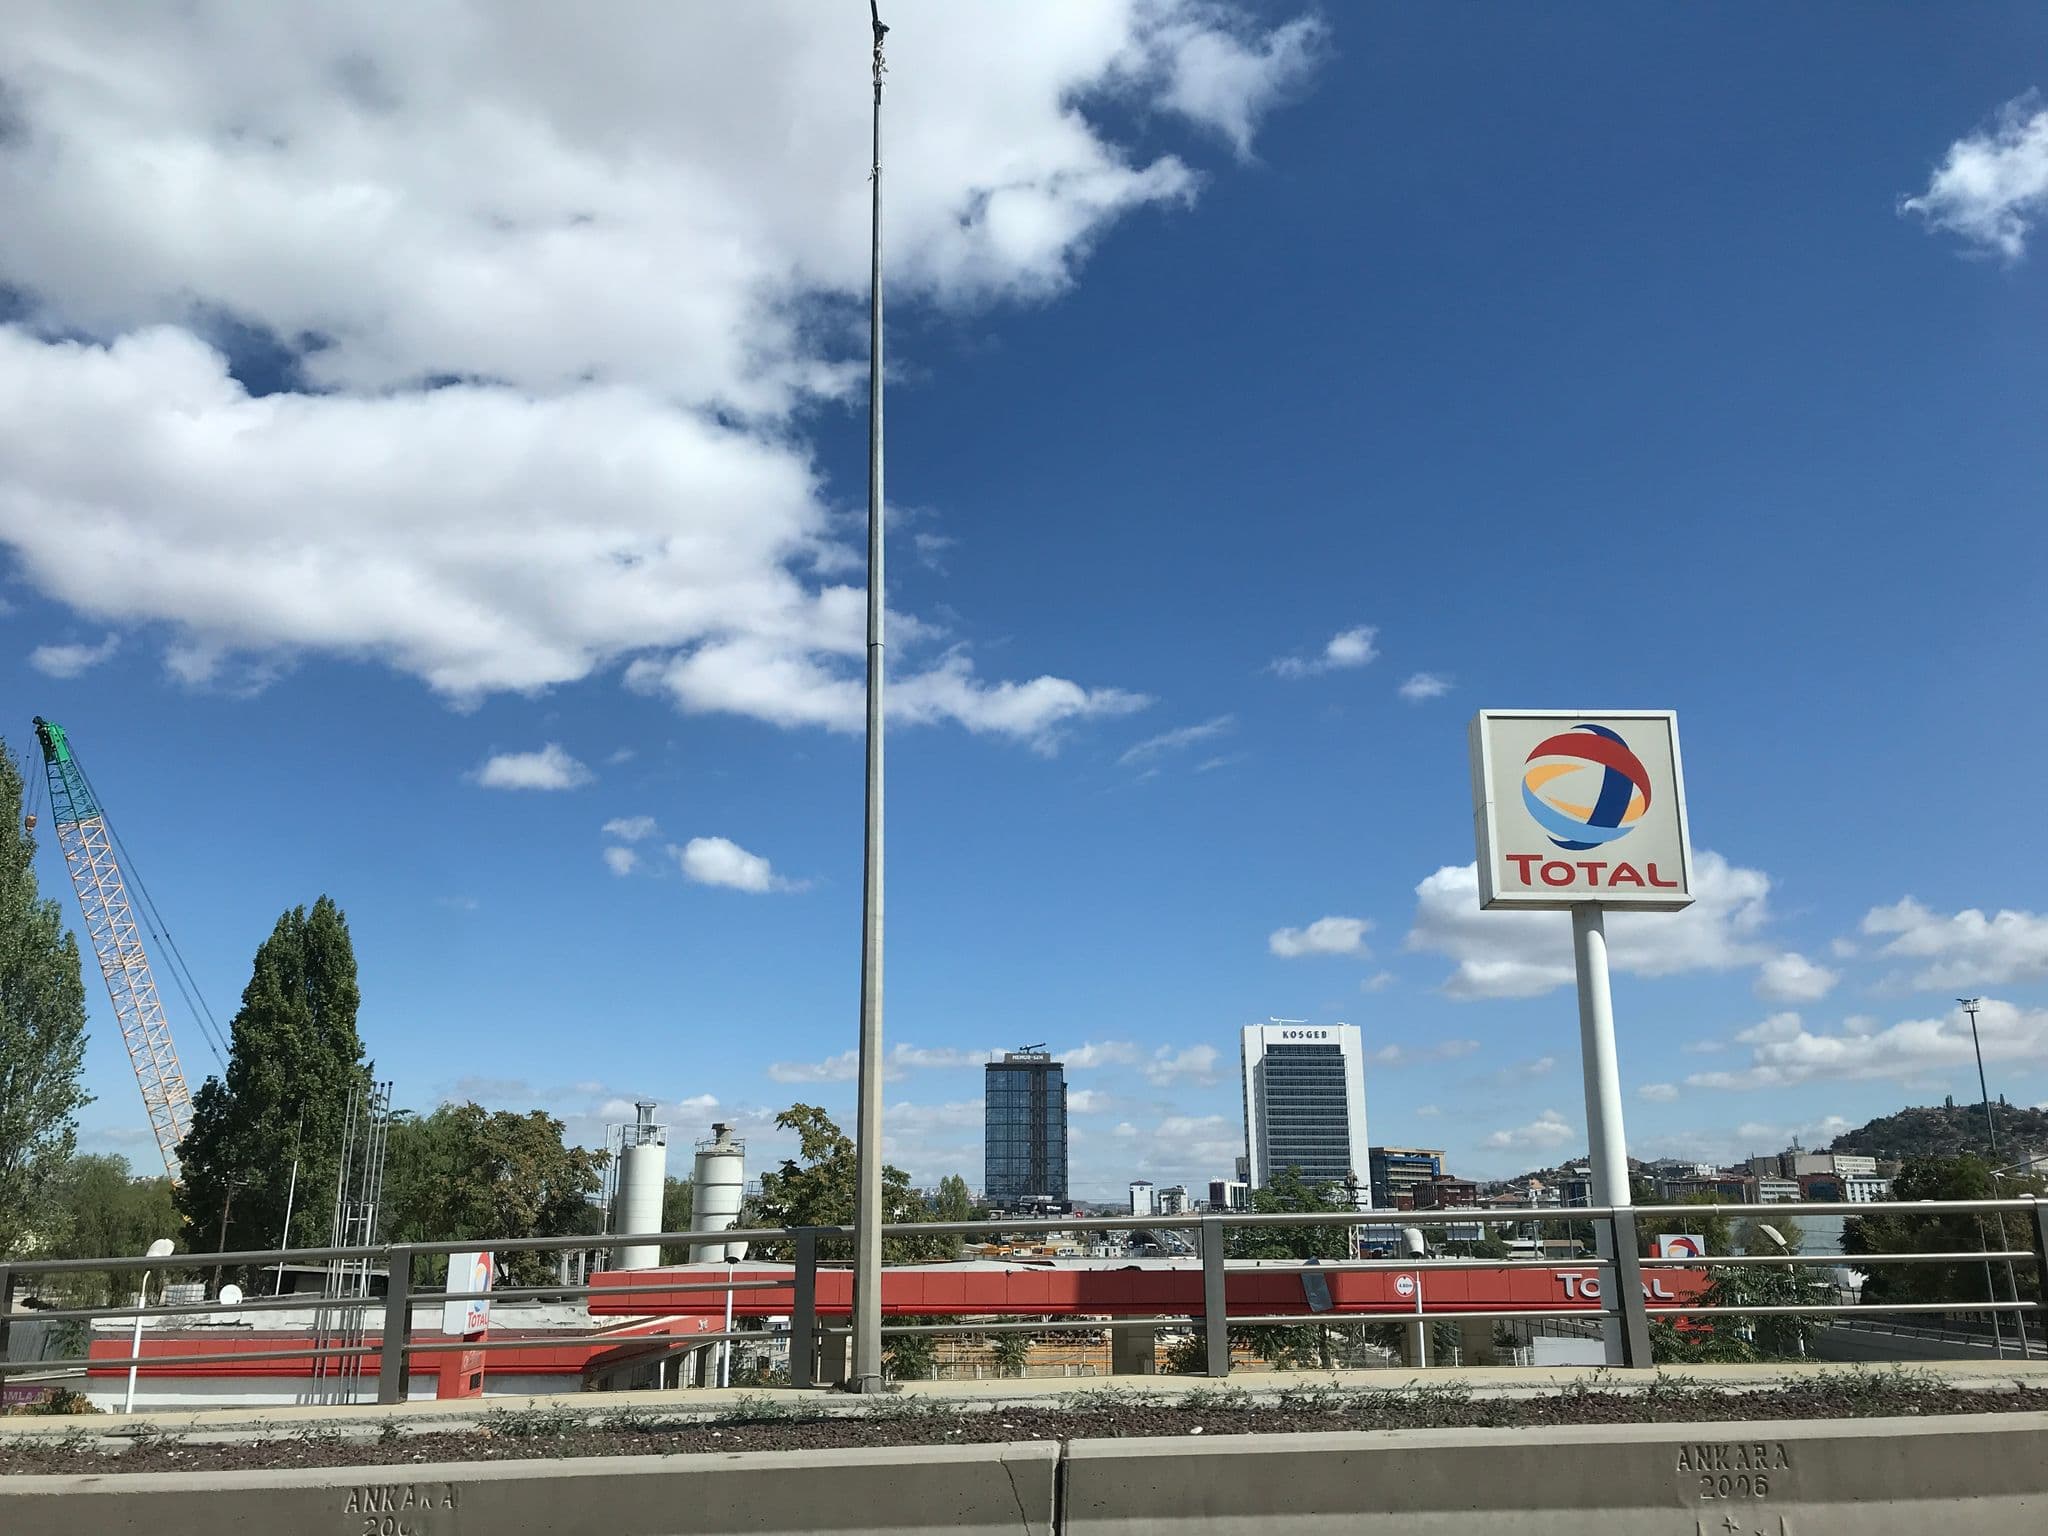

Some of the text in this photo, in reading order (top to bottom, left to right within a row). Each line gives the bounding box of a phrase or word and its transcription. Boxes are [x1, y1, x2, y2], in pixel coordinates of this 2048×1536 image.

[1506, 854, 1678, 888] TOTAL
[1282, 1030, 1328, 1039] KOSGEB
[1556, 1273, 1674, 1298] TOL
[467, 1311, 489, 1329] TOTAL
[1676, 1442, 1790, 1472] ANKARA
[1699, 1474, 1769, 1499] 2006
